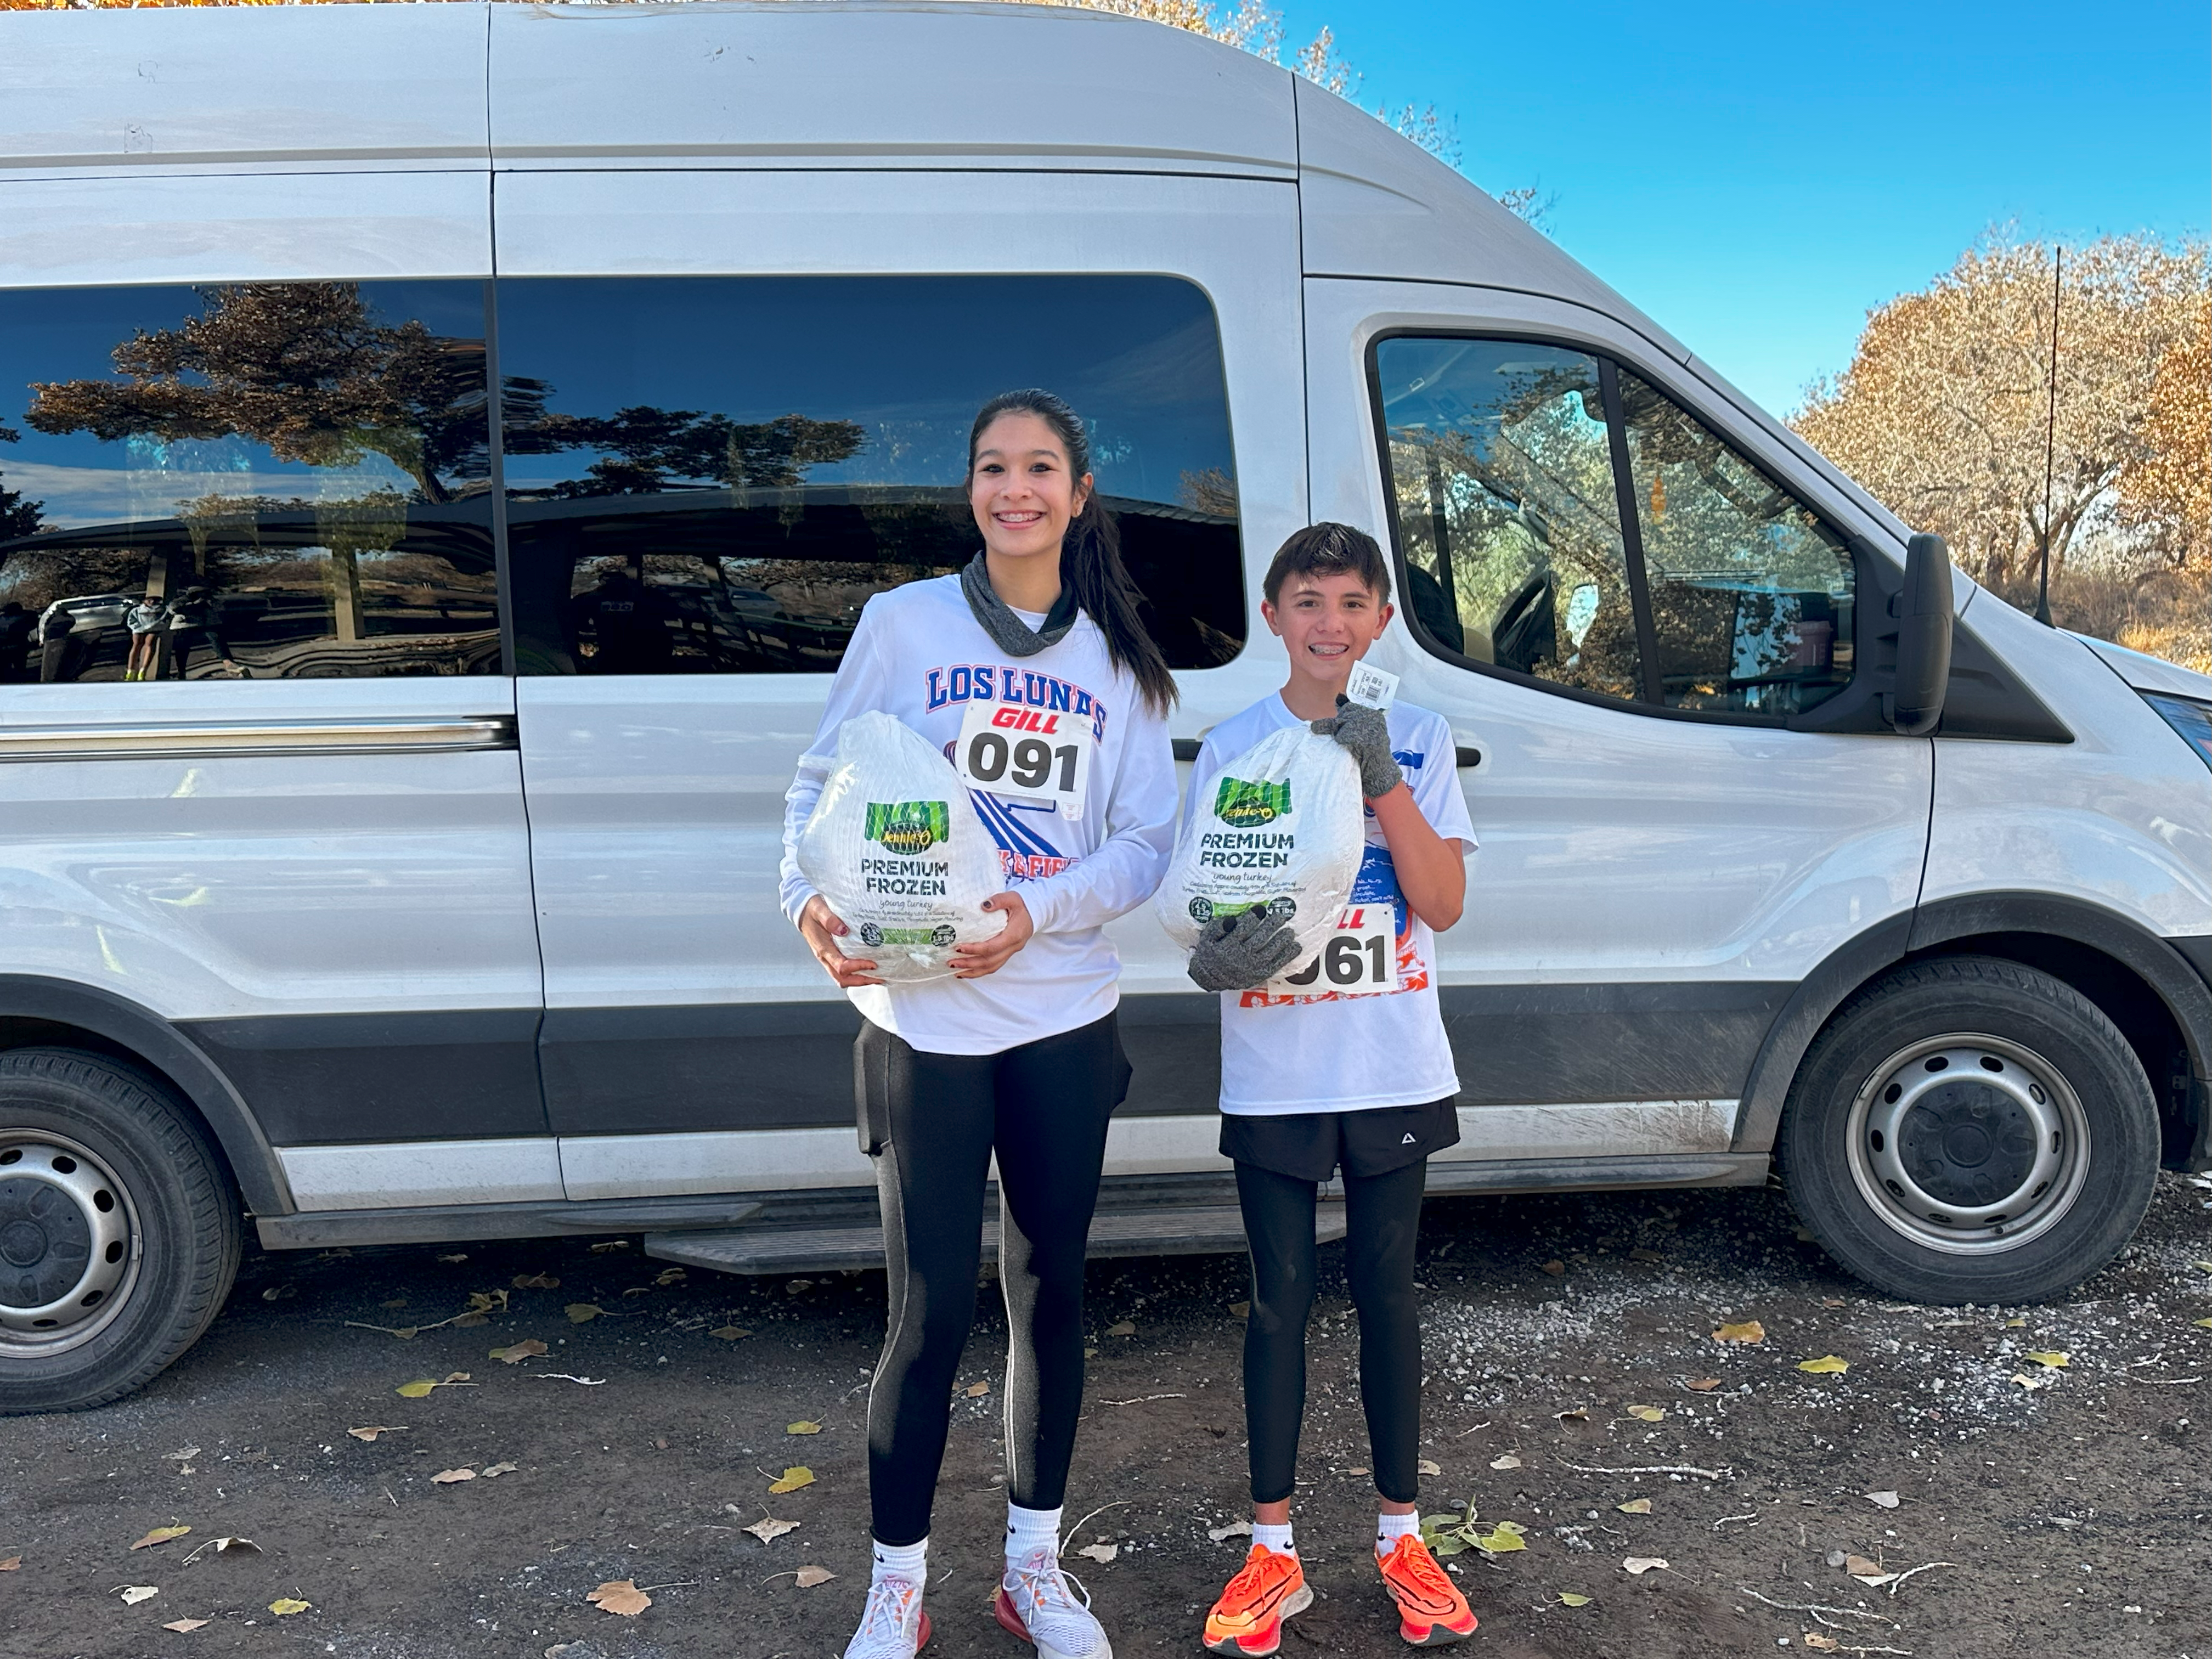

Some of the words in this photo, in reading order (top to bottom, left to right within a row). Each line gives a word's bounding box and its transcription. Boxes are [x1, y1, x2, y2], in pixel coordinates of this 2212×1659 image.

[926, 664, 996, 714] LOS
[1000, 665, 1107, 746] LUNAS
[991, 707, 1060, 735] GILL
[968, 732, 1079, 792] 091
[1200, 833, 1294, 849] PREMIUM
[861, 859, 949, 877] PREMIUM
[1028, 855, 1079, 879] FIE
[1200, 851, 1288, 868] FROZEN
[866, 877, 946, 895] FROZEN
[1211, 873, 1242, 884] young
[1243, 872, 1272, 883] turkey
[879, 900, 906, 910] young
[907, 899, 933, 910] turkey
[1336, 909, 1365, 929] LL
